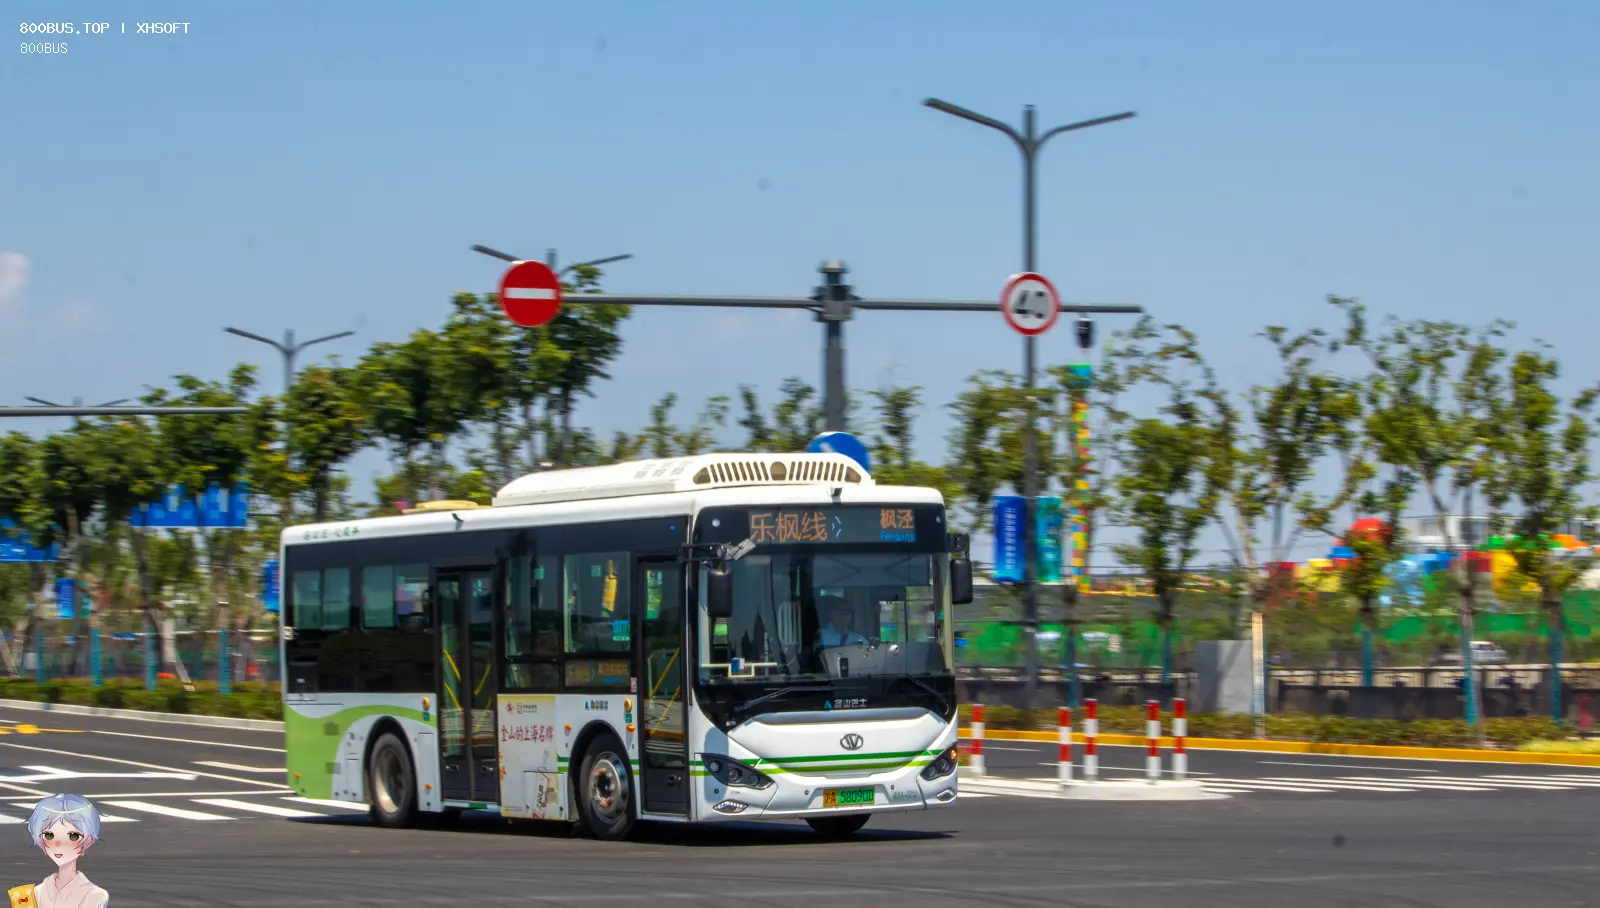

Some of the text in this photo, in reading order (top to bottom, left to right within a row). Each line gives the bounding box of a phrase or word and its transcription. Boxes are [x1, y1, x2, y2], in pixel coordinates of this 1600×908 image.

[1014, 289, 1048, 319] 40
[749, 511, 829, 543] 乐枫线
[879, 508, 915, 529] 枫泾
[834, 698, 868, 709] 金山巴士
[501, 724, 554, 742] 金山的上海名牌
